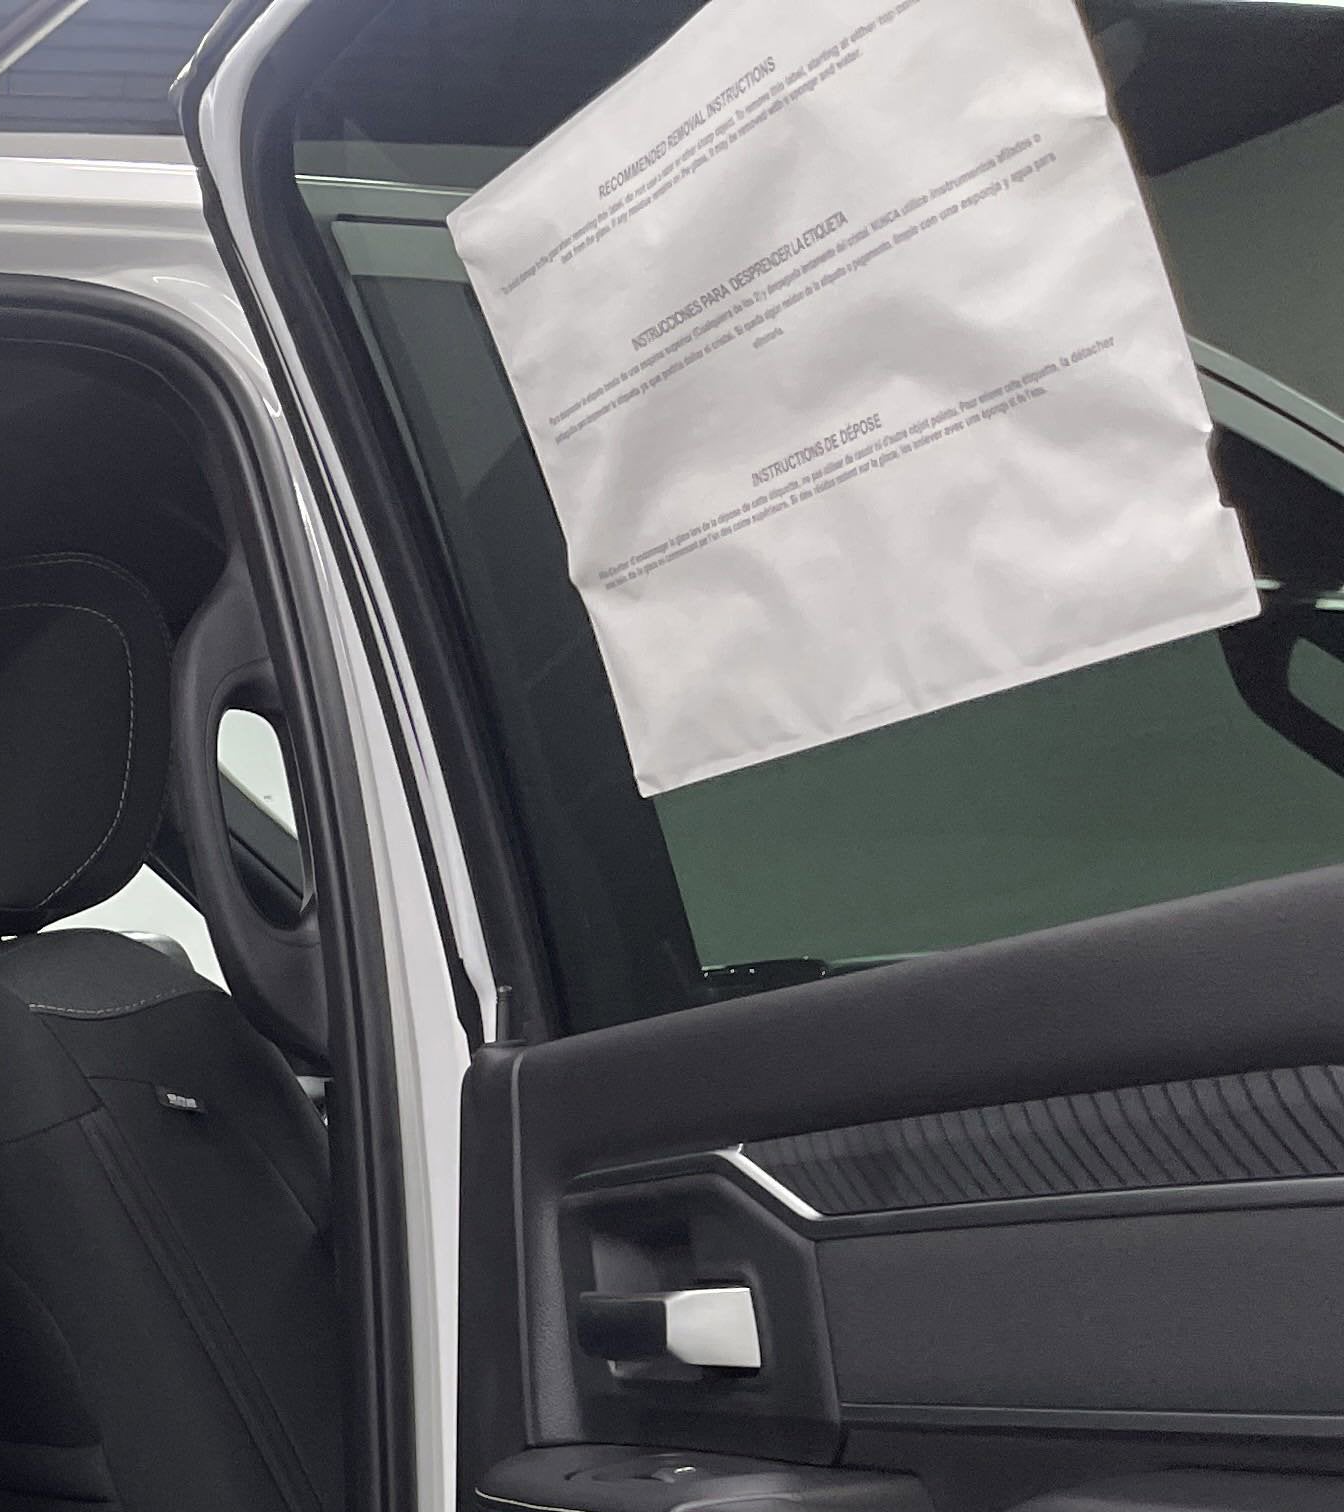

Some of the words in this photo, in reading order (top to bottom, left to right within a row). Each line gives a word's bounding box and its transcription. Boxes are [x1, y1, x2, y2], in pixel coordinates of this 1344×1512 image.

[599, 140, 667, 199] RECOMMENDED
[668, 111, 705, 149] REMOVAL
[706, 56, 776, 118] INSTRUCTIONS
[631, 300, 703, 350] INSTRUCCIONES
[700, 284, 731, 309] PARA
[729, 244, 792, 291] DESPRENDER
[791, 238, 805, 255] LA
[803, 211, 848, 248] ETIQUETA
[752, 441, 825, 487] INSTRUCTIONS
[824, 434, 839, 452] DE
[840, 413, 882, 445] DÉPOSE
